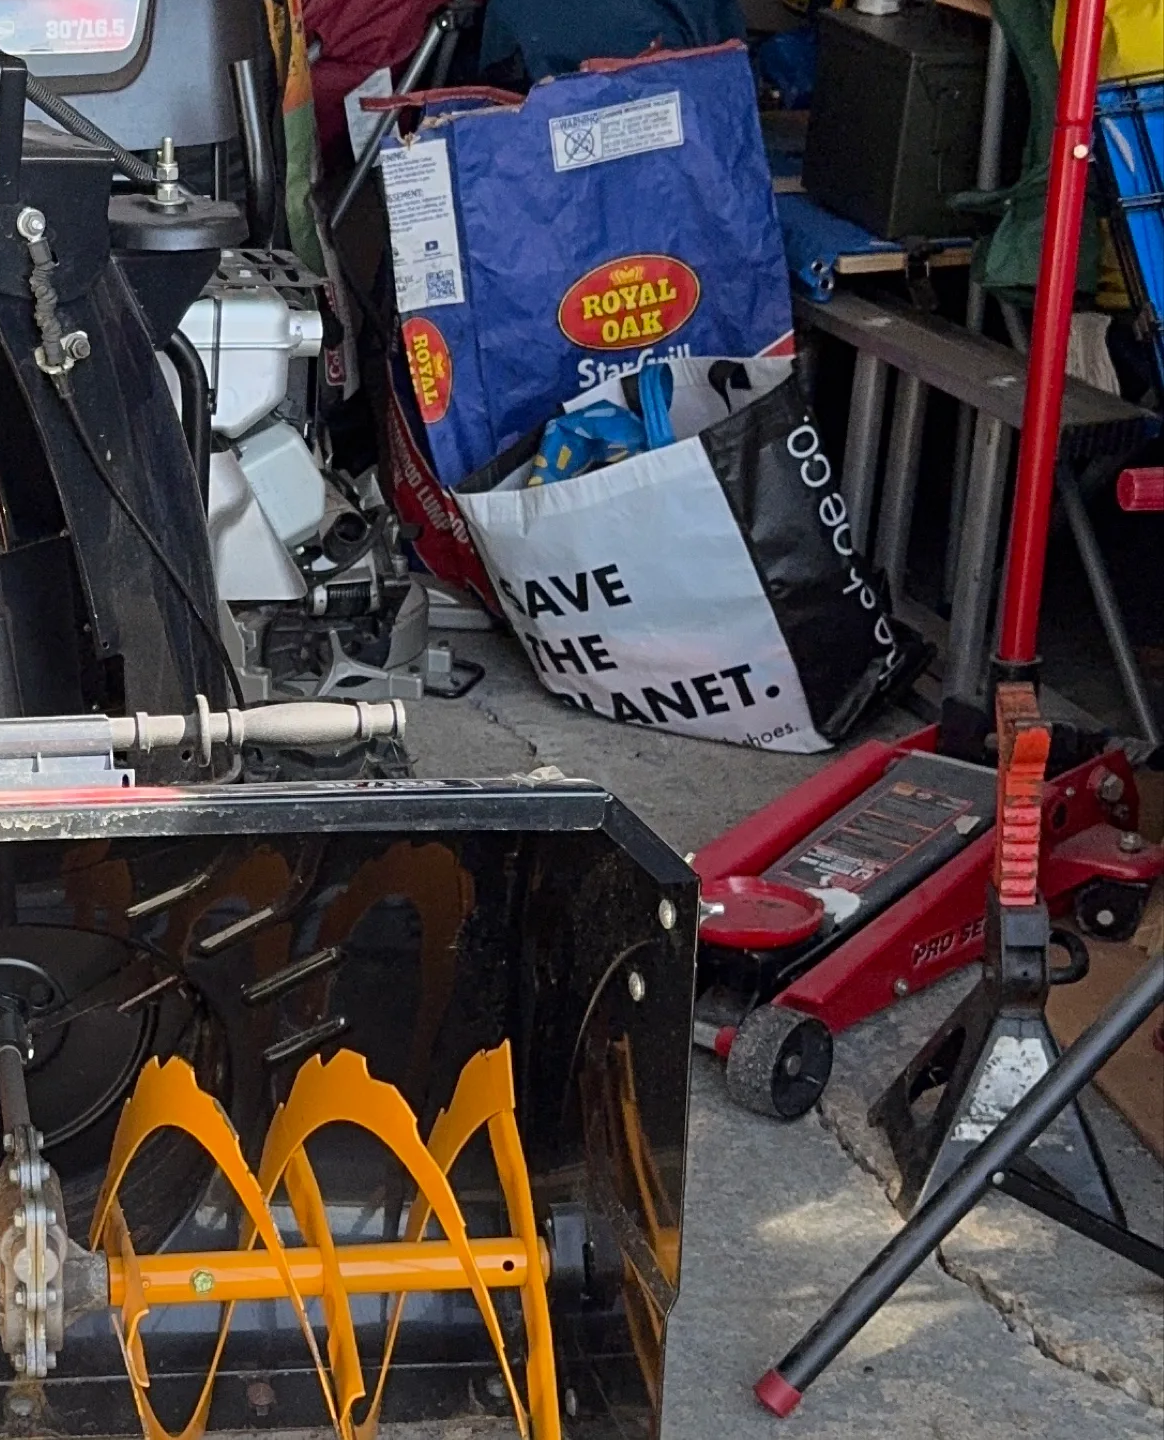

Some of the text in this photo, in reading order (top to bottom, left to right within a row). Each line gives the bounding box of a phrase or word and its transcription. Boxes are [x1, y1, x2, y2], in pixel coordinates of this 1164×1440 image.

[581, 277, 678, 321] ROYAL
[602, 309, 664, 343] OAK
[412, 332, 440, 406] ROYAL
[497, 563, 633, 619] SAVE
[523, 633, 619, 675] THE
[911, 934, 958, 967] PRO
